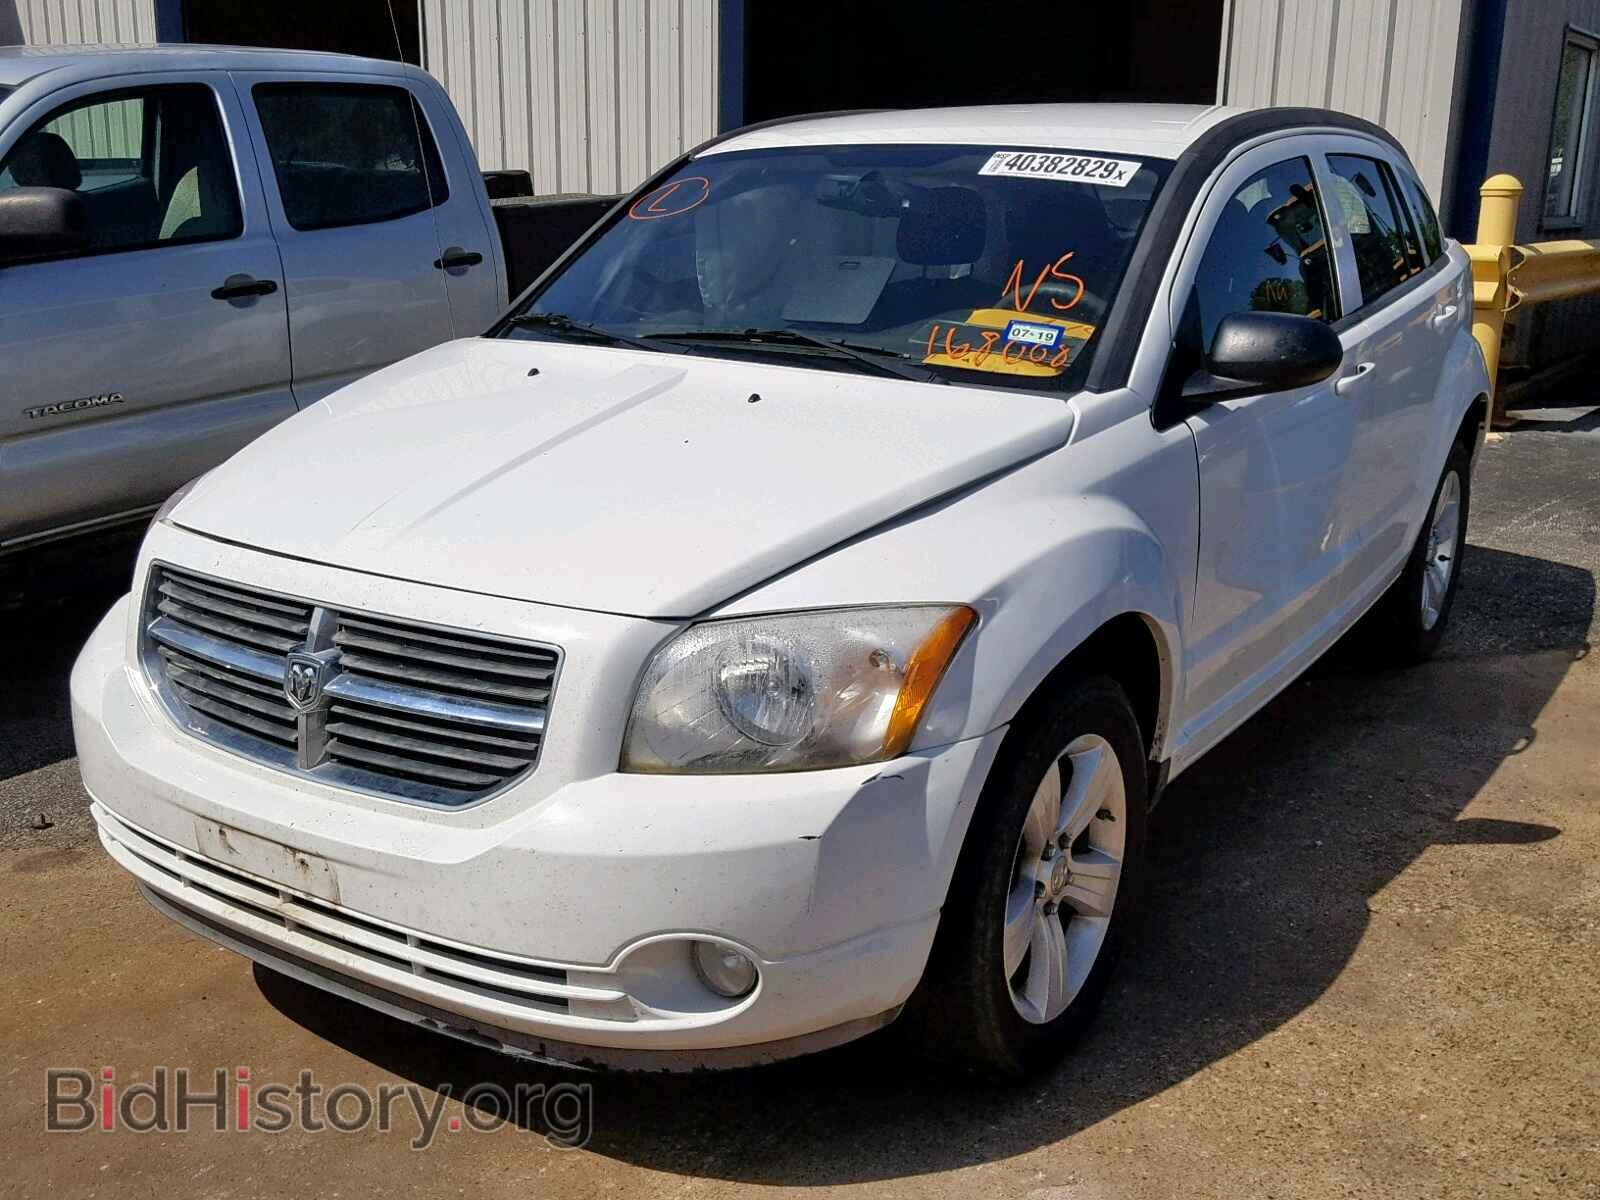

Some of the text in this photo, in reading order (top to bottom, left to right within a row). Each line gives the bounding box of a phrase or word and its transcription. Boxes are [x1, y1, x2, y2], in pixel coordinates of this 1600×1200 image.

[1002, 251, 1085, 312] NS
[1011, 327, 1055, 342] 07-19
[23, 392, 125, 419] TACOMA
